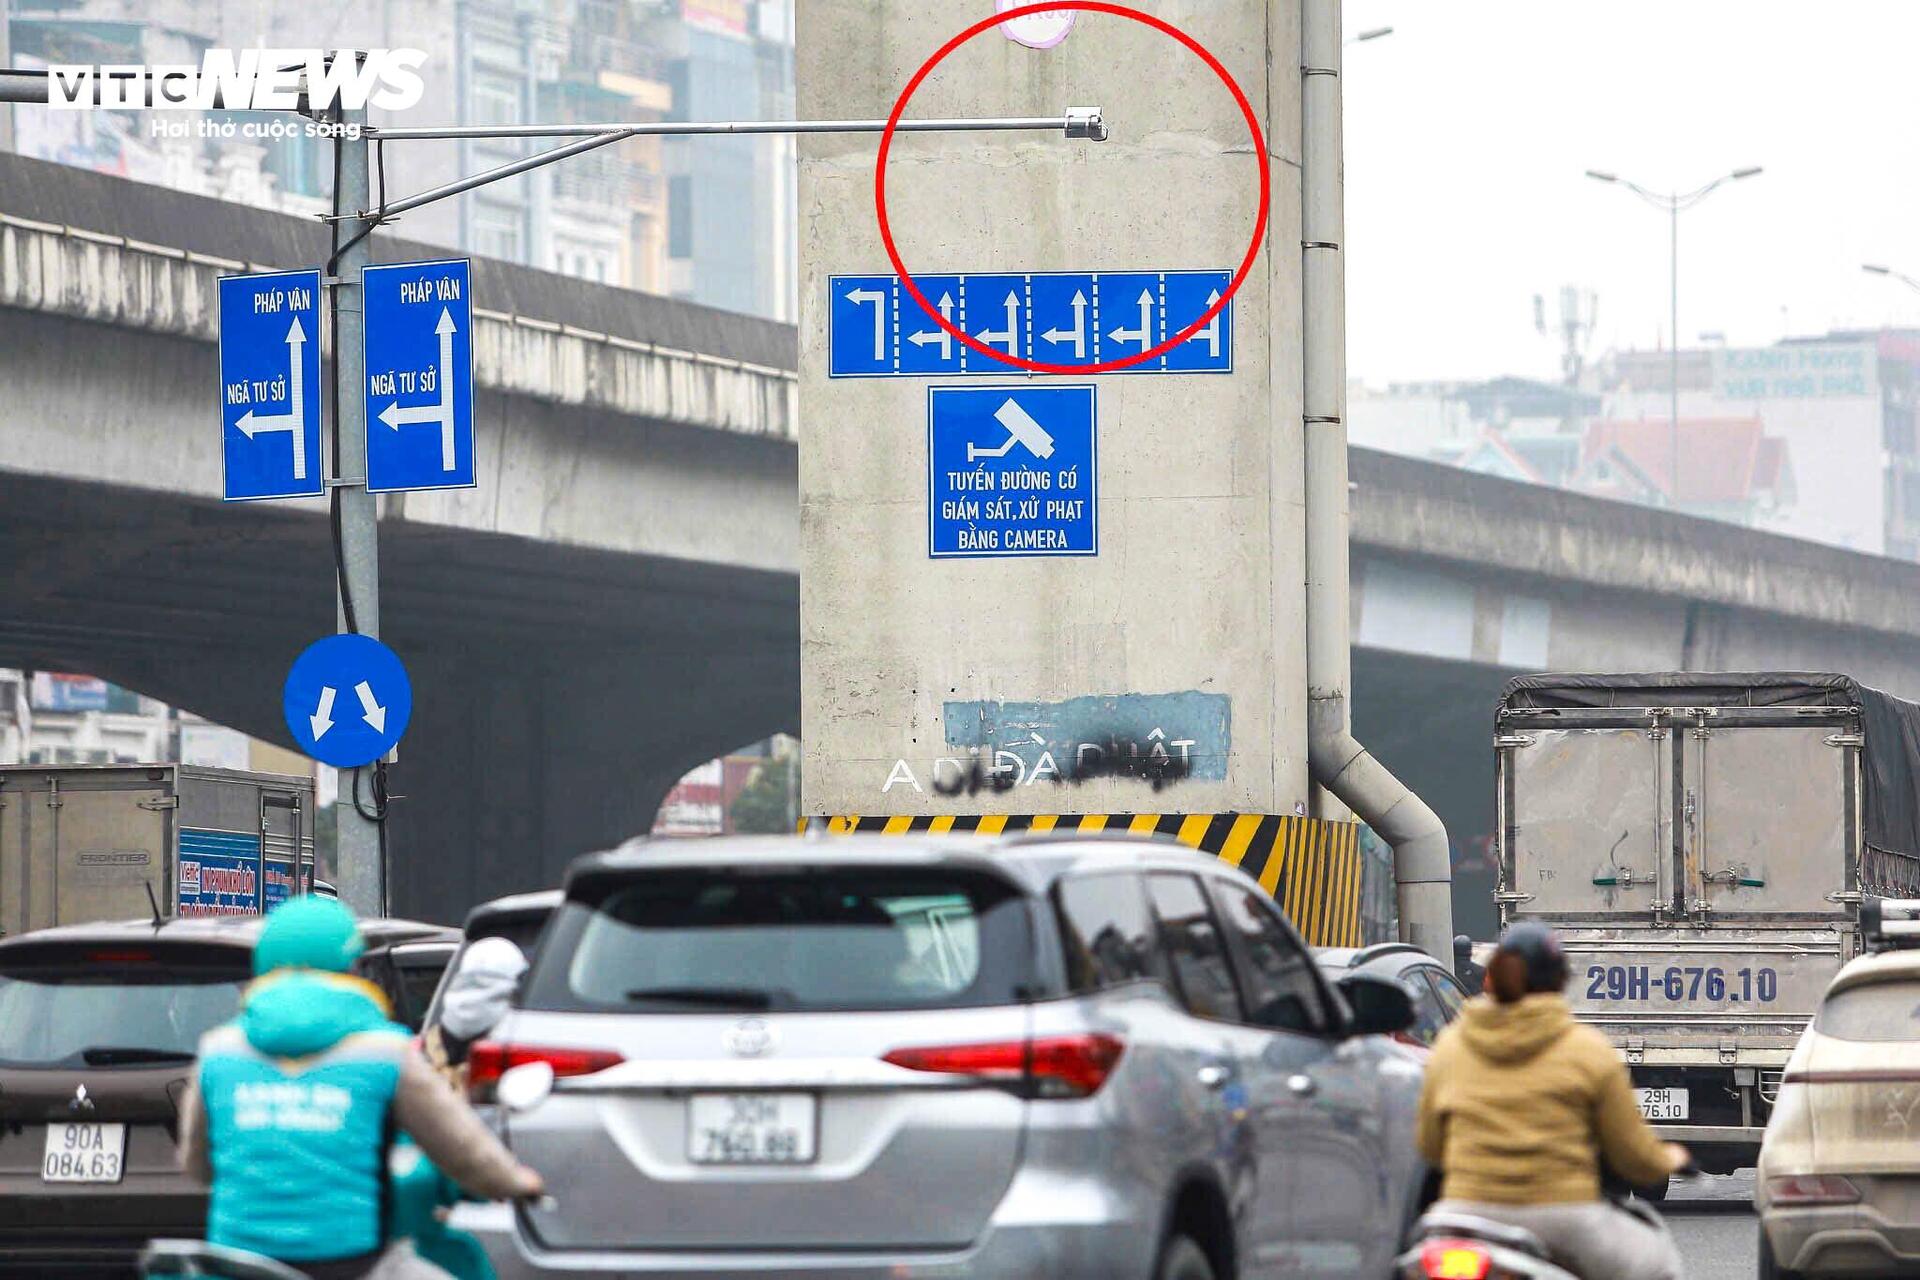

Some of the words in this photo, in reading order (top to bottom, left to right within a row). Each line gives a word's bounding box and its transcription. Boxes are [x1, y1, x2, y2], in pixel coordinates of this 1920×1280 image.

[254, 287, 283, 314] PHÁP
[287, 286, 311, 312] VÂN
[401, 276, 432, 304] PHÁP
[435, 272, 460, 301] VÂN
[227, 379, 250, 404] NGÃ
[252, 380, 269, 402] TƯ
[270, 374, 286, 402] SỞ
[371, 370, 396, 396] NGÃ
[399, 371, 417, 394] TƯ
[420, 365, 437, 392] SỞ
[947, 462, 995, 491] TUYẾN
[1000, 464, 1051, 491] ĐƯỜNG
[1058, 464, 1078, 489] CÓ
[942, 495, 980, 520] GIÁM
[1046, 500, 1084, 522] PHẠT
[958, 521, 999, 549] BẰNG
[1004, 529, 1068, 549] CAMERA
[1586, 965, 1777, 1002] 29H-676.10
[1644, 1090, 1671, 1104] 29H
[65, 1123, 104, 1150] 90A
[46, 1152, 119, 1178] 084.63
